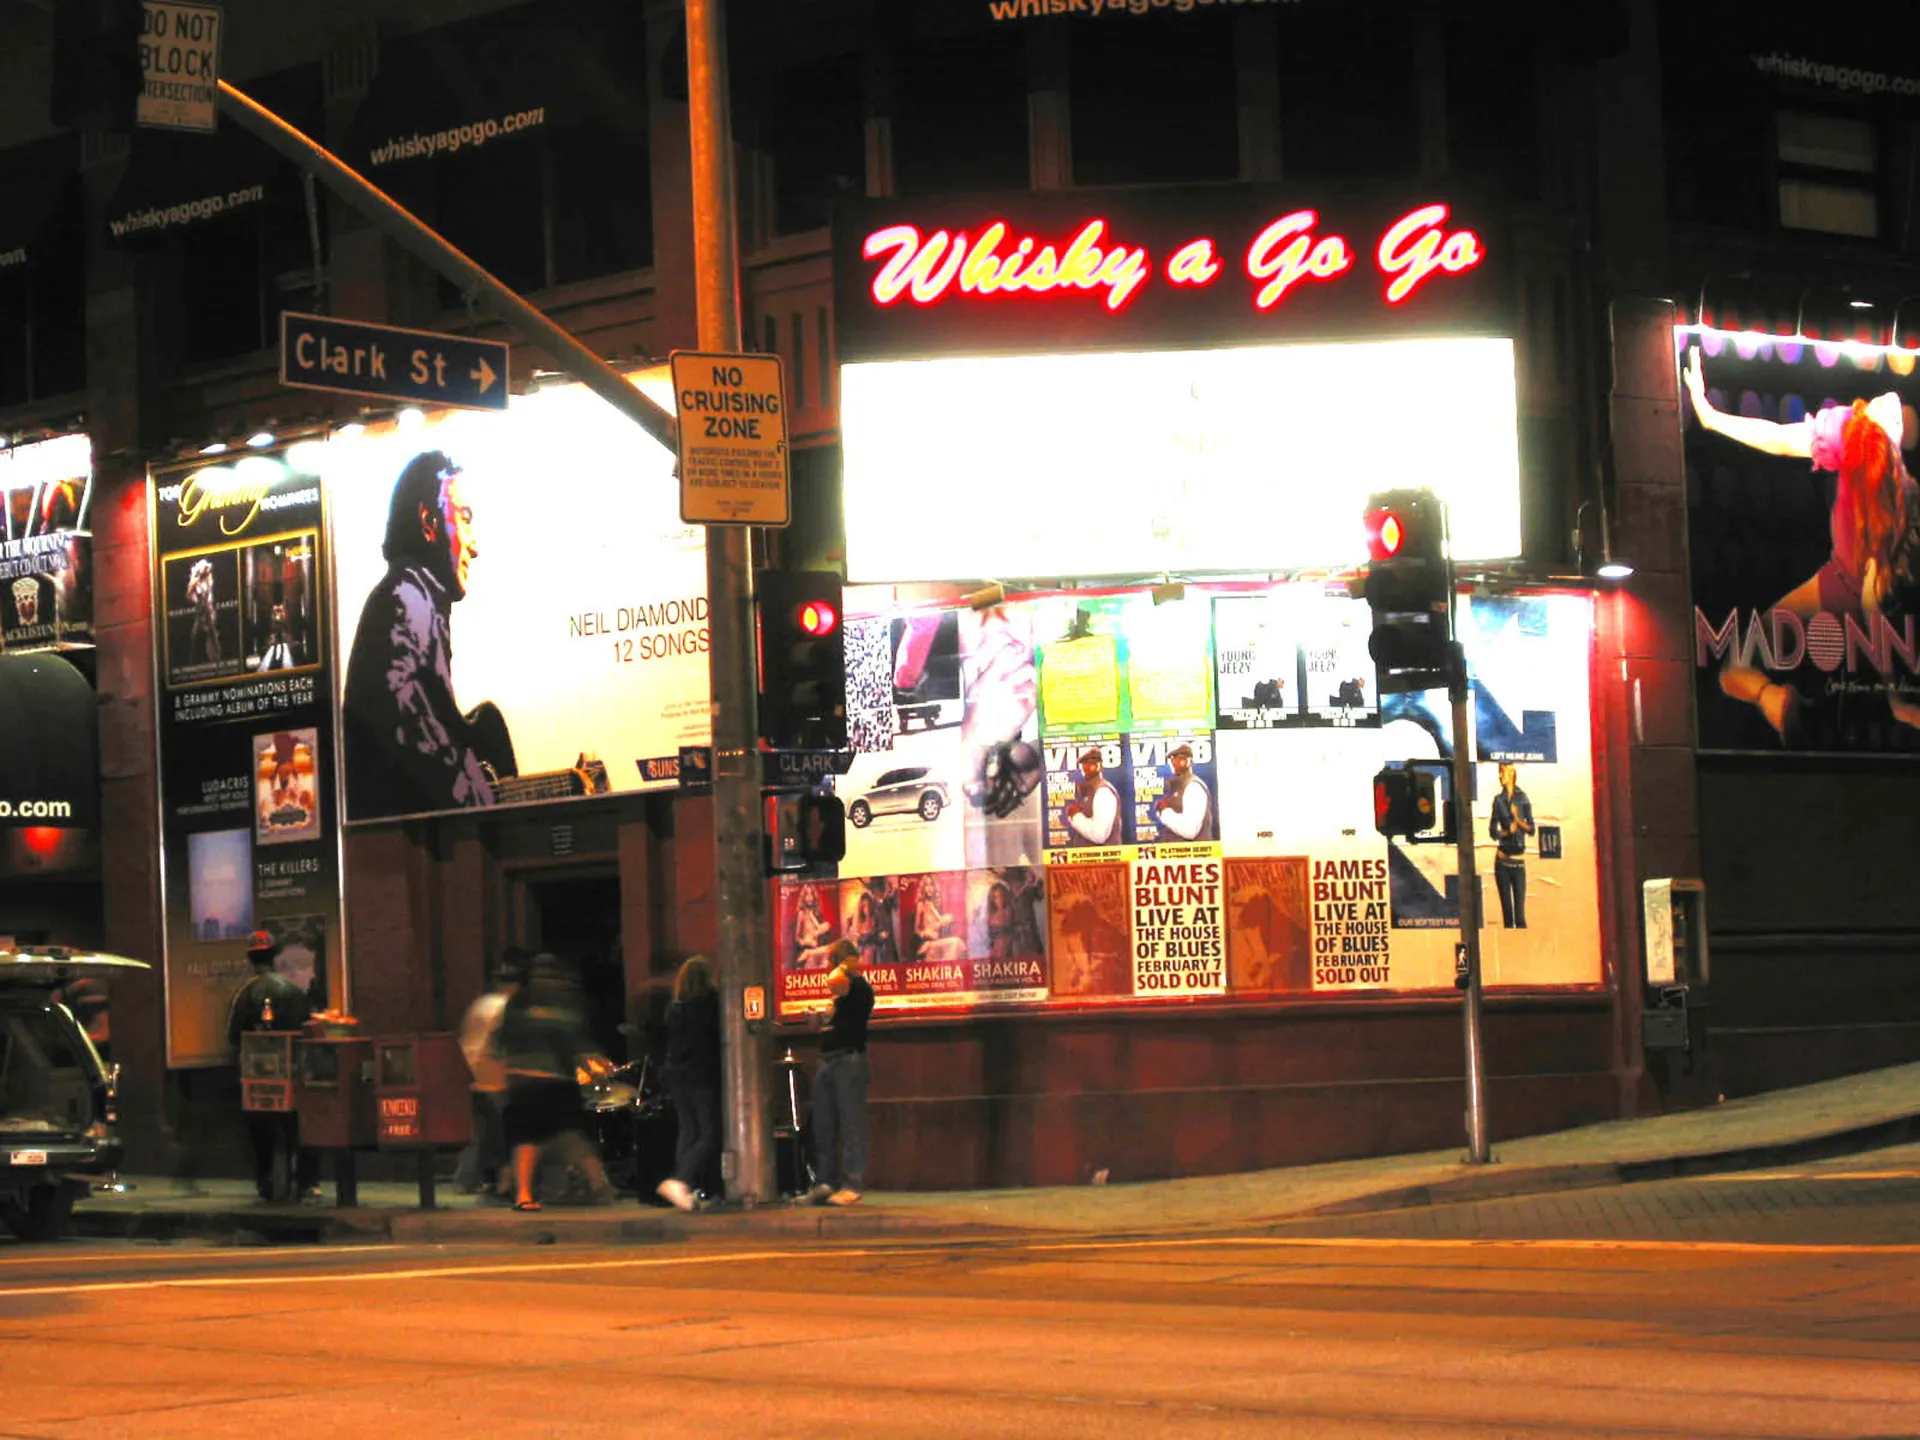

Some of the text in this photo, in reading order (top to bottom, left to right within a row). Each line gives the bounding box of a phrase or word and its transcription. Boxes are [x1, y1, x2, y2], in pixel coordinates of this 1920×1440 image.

[175, 12, 217, 42] NOT
[370, 105, 546, 165] whiskyagogo.com
[110, 182, 264, 237] whiskyagogo.com
[862, 202, 1486, 311] Whisky a Go Go
[295, 334, 447, 388] Clark St
[712, 366, 743, 387] NO
[681, 389, 780, 414] CRUISING
[704, 416, 762, 440] ZONE
[570, 597, 710, 638] NEIL DIAMOND
[614, 628, 711, 663] 12 SONGS
[1694, 604, 1920, 676] MADONN
[1220, 662, 1252, 674] JEEZY
[184, 691, 219, 707] GRAMMY
[222, 680, 287, 701] NOMINATIONS
[289, 676, 314, 692] EACH
[174, 691, 314, 722] INCLUDING ALBUM OF THE YEAR
[780, 755, 834, 772] CLARK
[202, 775, 249, 793] LUDACRIS
[258, 858, 319, 876] THE KILLERS
[1135, 864, 1220, 886] JAMES
[1313, 860, 1387, 880] JAMES
[1135, 885, 1219, 907] BLUNT
[1314, 881, 1387, 902] BLUNT
[1135, 907, 1220, 927] LIVE AT
[1314, 902, 1387, 921] LIVE AT
[1136, 926, 1221, 941] THE HOUSE
[1315, 921, 1389, 936] THE HOUSE
[1137, 941, 1222, 959] OF BLUES
[1315, 936, 1389, 954] OF BLUES
[973, 960, 1041, 979] SHAKIRA
[1137, 958, 1222, 973] FEBRUARY 7
[1316, 953, 1390, 967] FEBRUARY 7
[785, 972, 828, 990] SHAKIR
[862, 968, 897, 985] AKIRA
[906, 965, 963, 983] SHAKIRA
[1137, 972, 1222, 990] SOLD OUT
[1316, 967, 1390, 985] SOLD OUT
